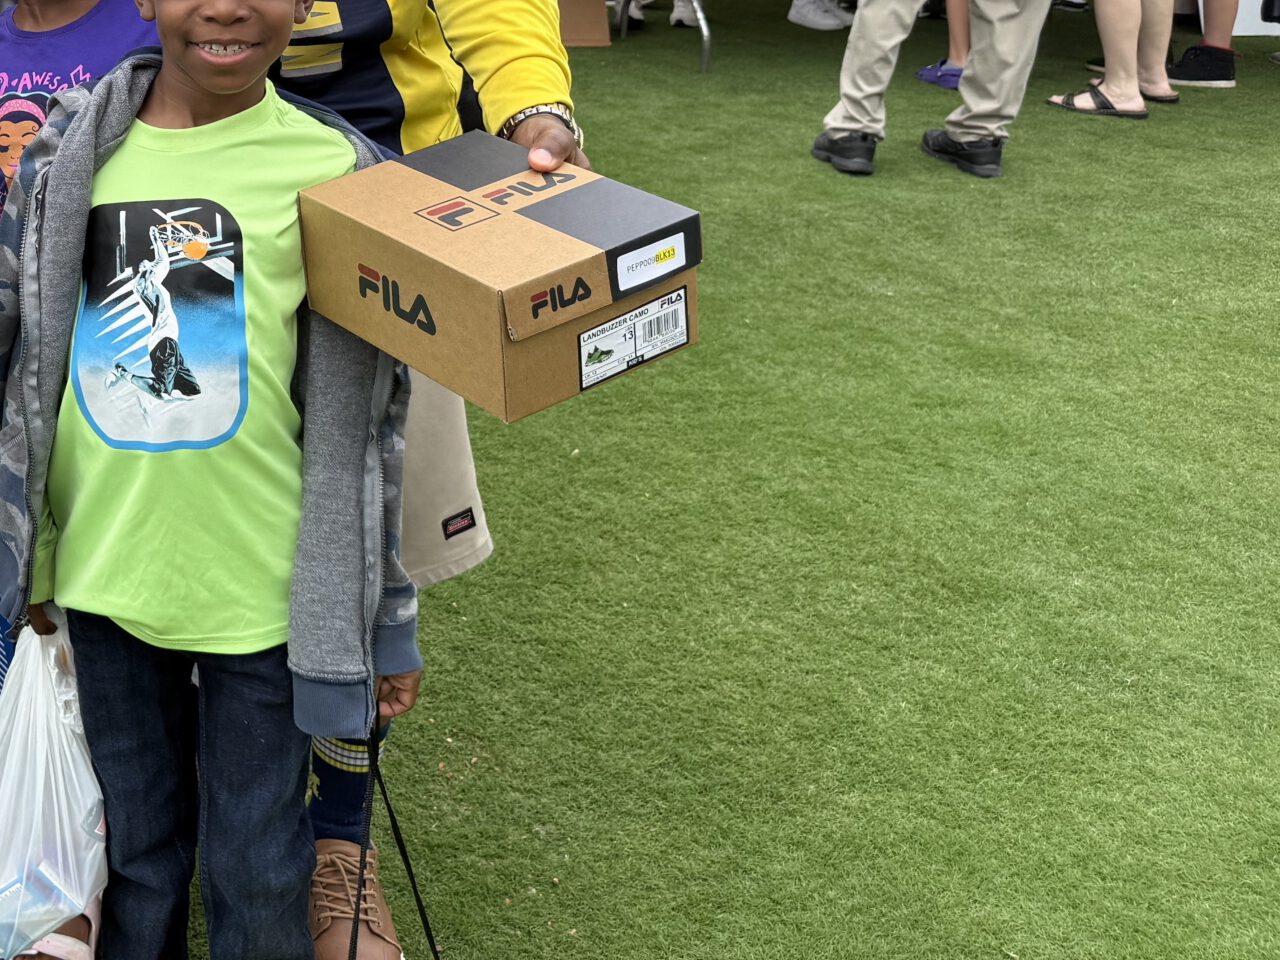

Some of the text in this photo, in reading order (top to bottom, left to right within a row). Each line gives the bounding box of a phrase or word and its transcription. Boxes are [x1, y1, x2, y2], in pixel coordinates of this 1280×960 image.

[482, 172, 577, 205] FILA
[357, 263, 437, 336] FILA
[530, 276, 592, 320] FILA
[582, 317, 628, 343] LANDBUZZER
[629, 307, 649, 323] CAMO
[660, 292, 683, 310] FILA
[622, 330, 634, 343] 13
